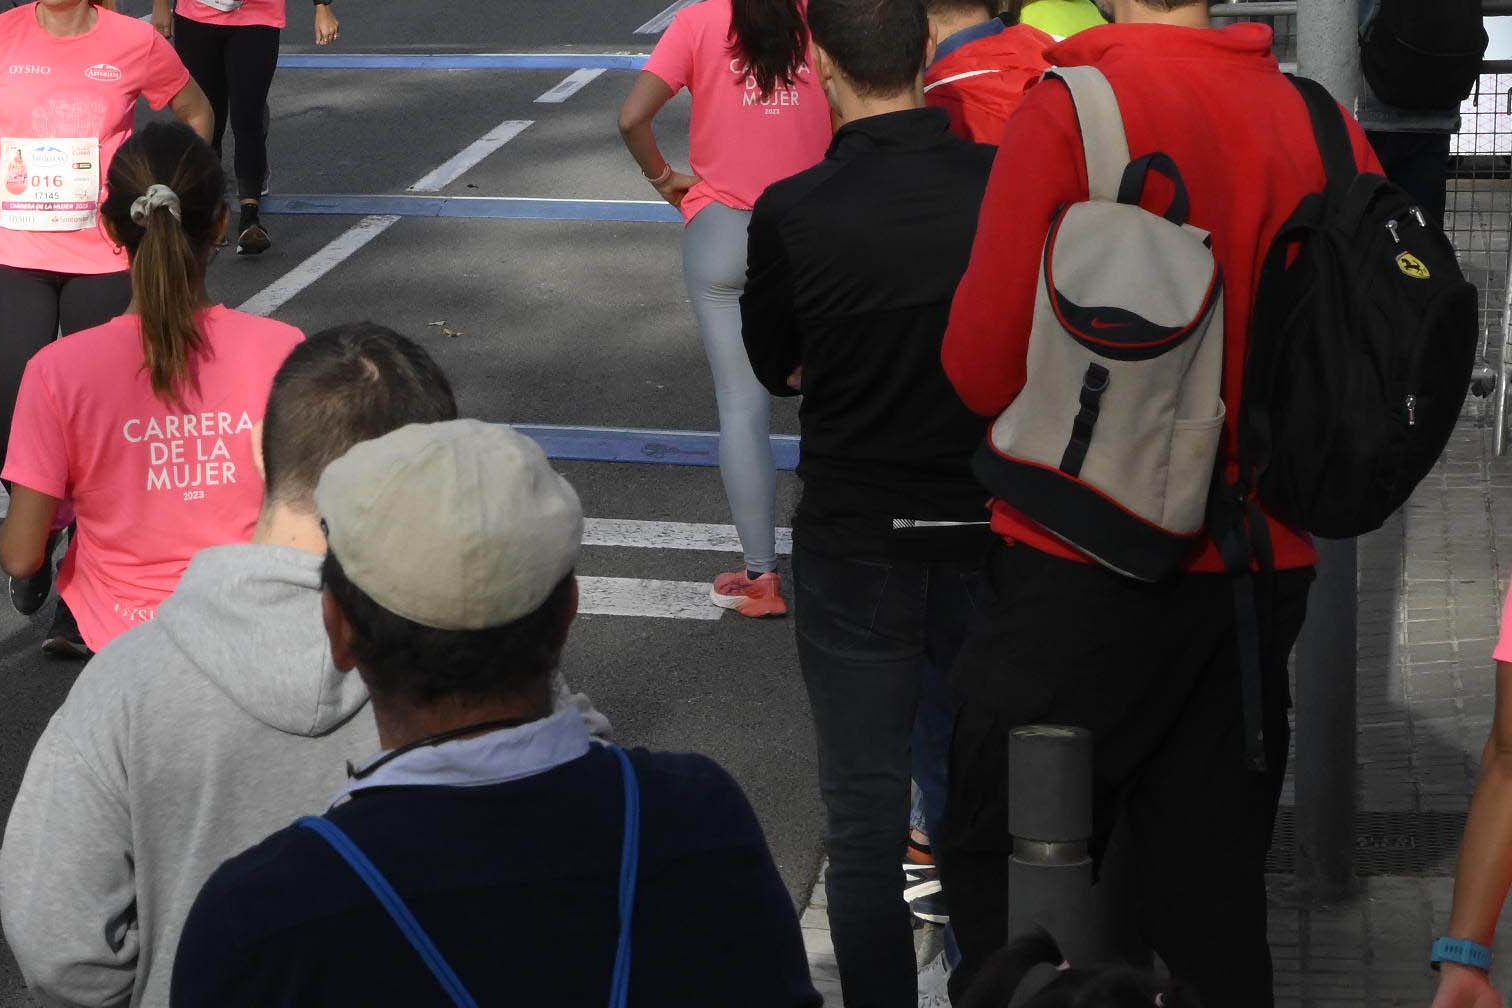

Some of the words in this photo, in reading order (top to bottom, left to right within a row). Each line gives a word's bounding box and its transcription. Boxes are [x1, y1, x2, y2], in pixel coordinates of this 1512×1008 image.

[8, 64, 50, 74] OYSHO
[31, 175, 63, 188] 016
[34, 191, 59, 200] 17145
[123, 411, 254, 443] CARRERA
[150, 440, 184, 465] DE
[197, 438, 231, 461] LA
[146, 462, 237, 491] MUJER
[183, 490, 205, 501] 2023
